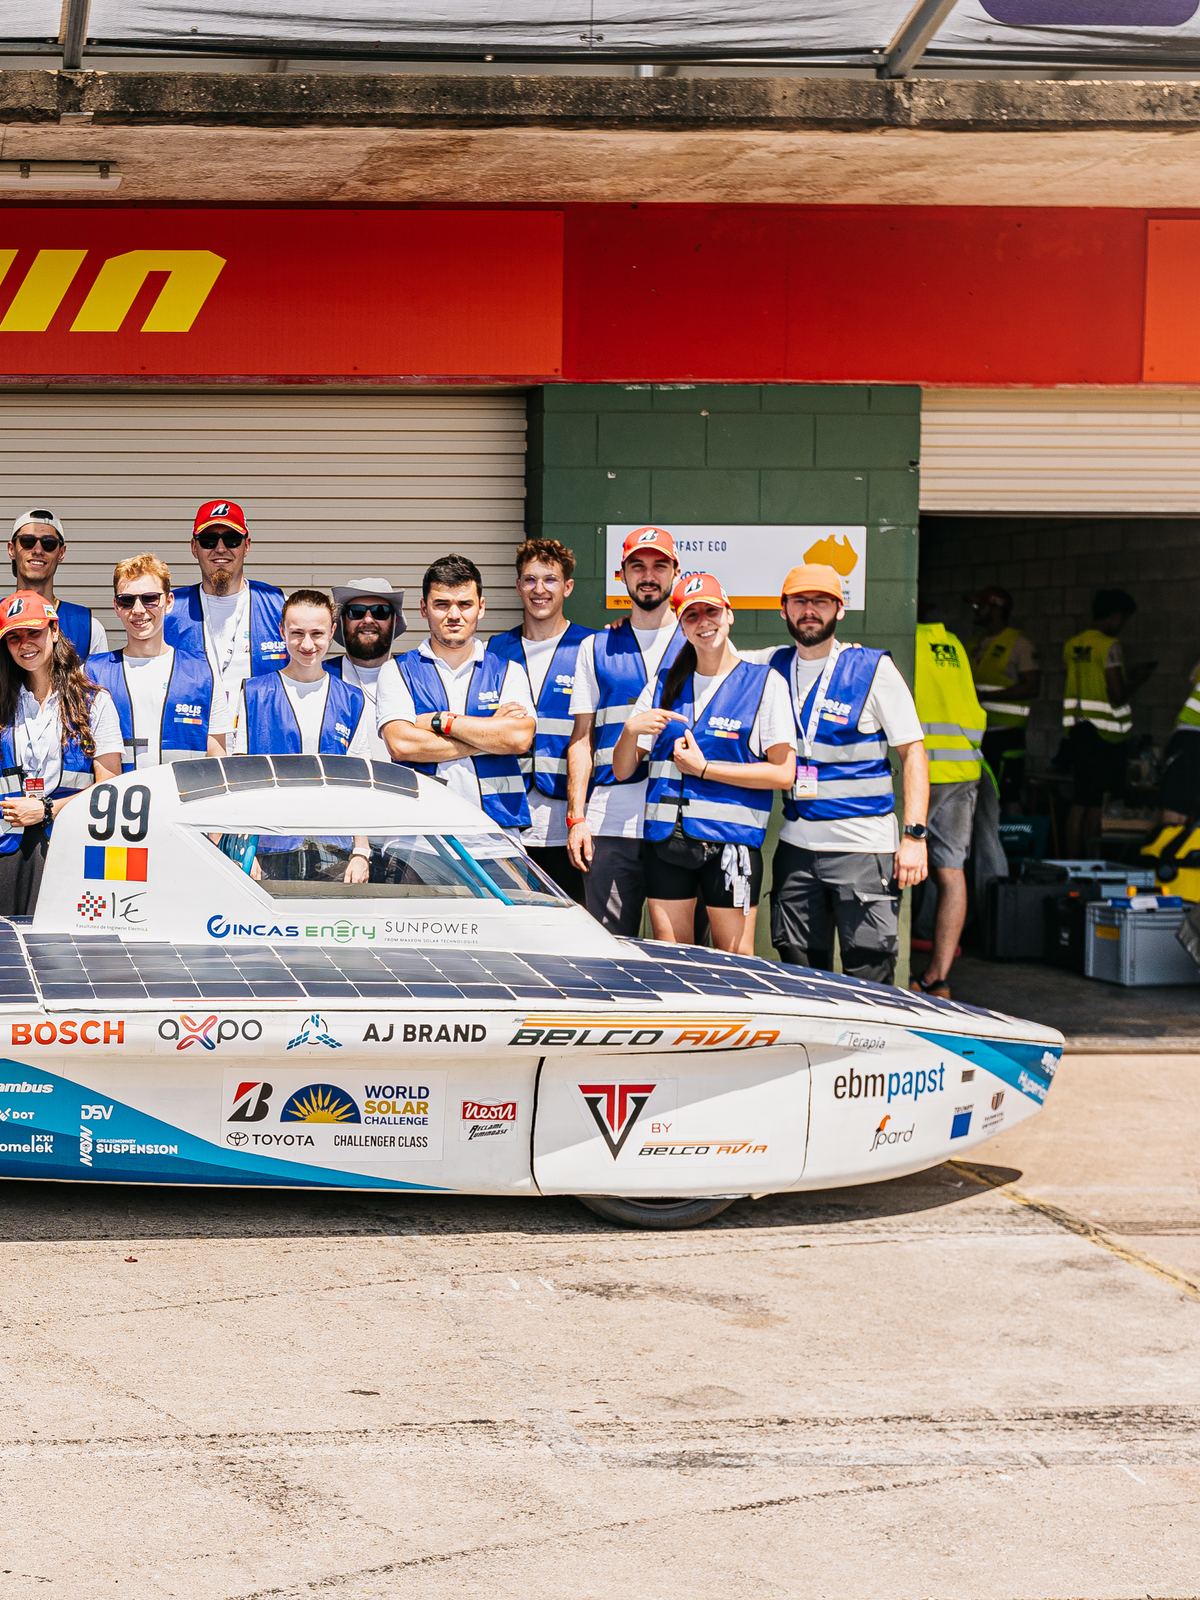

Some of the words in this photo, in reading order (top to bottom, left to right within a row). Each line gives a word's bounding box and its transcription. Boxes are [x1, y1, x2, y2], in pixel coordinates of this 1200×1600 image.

[708, 540, 727, 552] ECO
[87, 783, 152, 843] 99
[233, 924, 300, 938] INCAS
[384, 920, 479, 936] SUNPOWER
[11, 1020, 125, 1046] BOSCH
[362, 1023, 395, 1042] AJ
[402, 1023, 488, 1043] BRAND
[833, 1061, 946, 1104] ebmpapst
[364, 1084, 430, 1099] WORLD
[80, 1104, 114, 1120] DSV
[364, 1099, 430, 1116] SOLAR
[12, 1111, 36, 1120] DOT
[364, 1115, 430, 1126] CHALLENGE
[651, 1122, 672, 1134] BY
[95, 1143, 179, 1155] SUSPENSION
[252, 1134, 315, 1147] TOYOTA
[333, 1135, 397, 1148] CHALLENGER
[398, 1135, 429, 1149] CLASS
